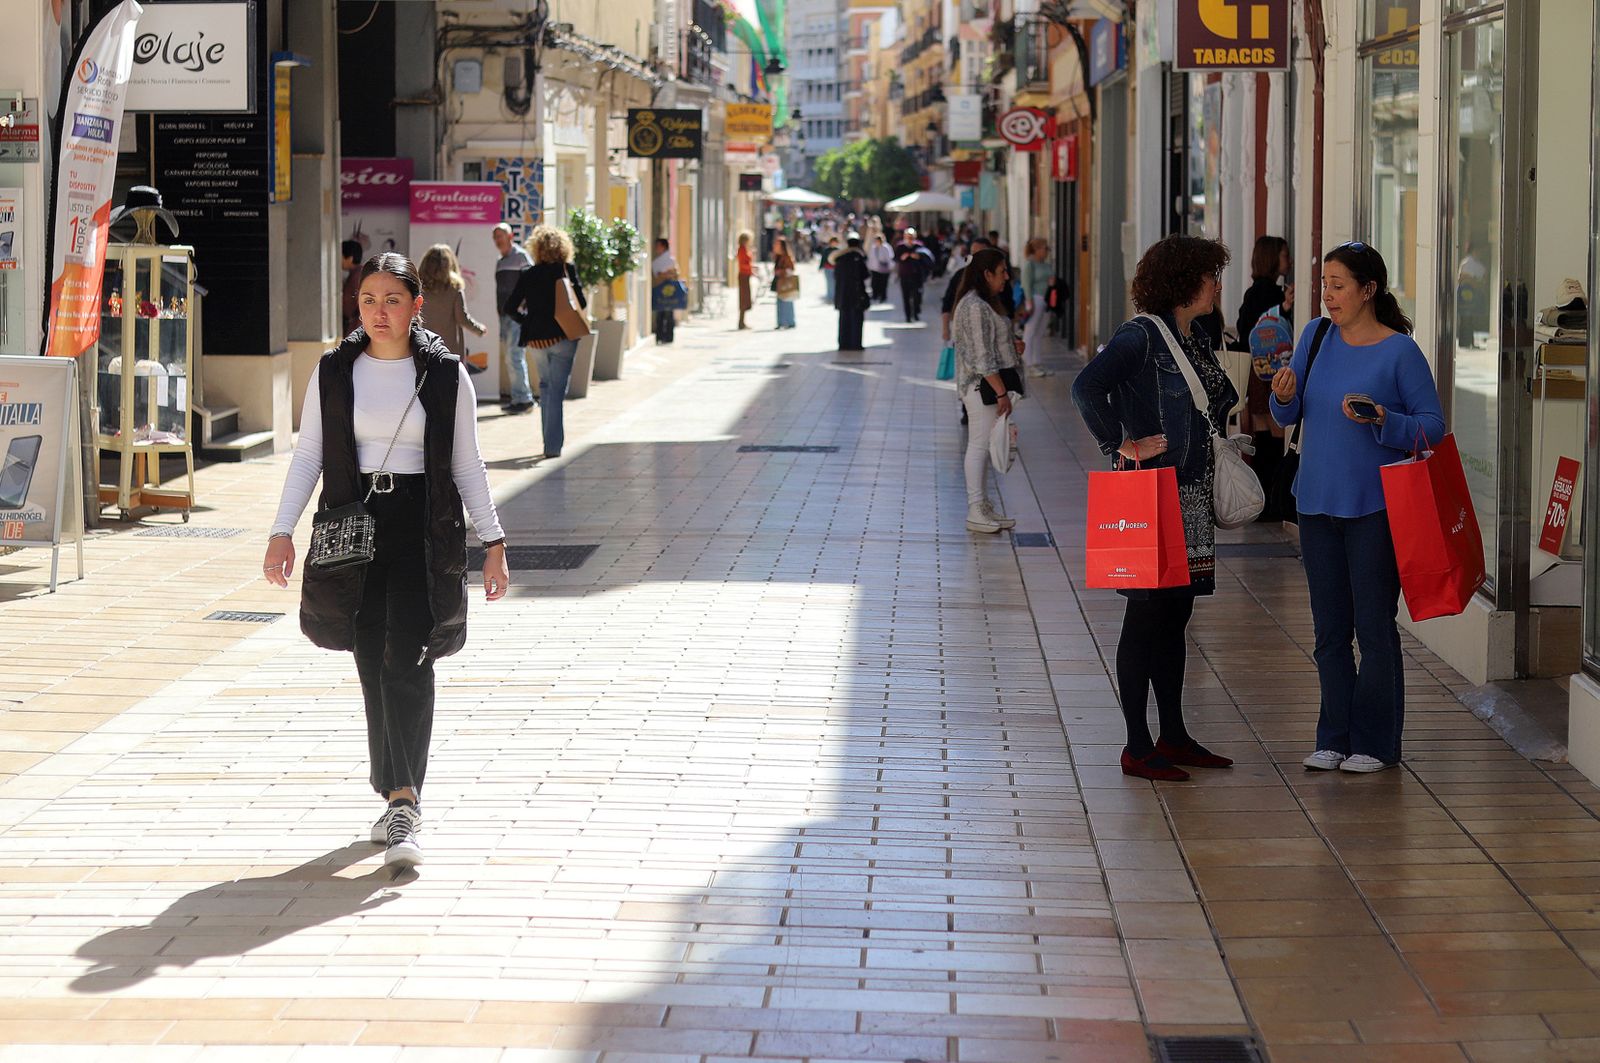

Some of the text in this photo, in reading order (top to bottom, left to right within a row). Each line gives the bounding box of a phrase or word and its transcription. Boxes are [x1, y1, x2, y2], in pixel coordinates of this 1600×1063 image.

[133, 31, 225, 72] Olaje
[1193, 48, 1276, 65] TABACOS
[70, 170, 78, 178] TU
[70, 215, 79, 253] 1
[76, 217, 88, 254] HORA
[6, 512, 44, 521] HIDROGEL
